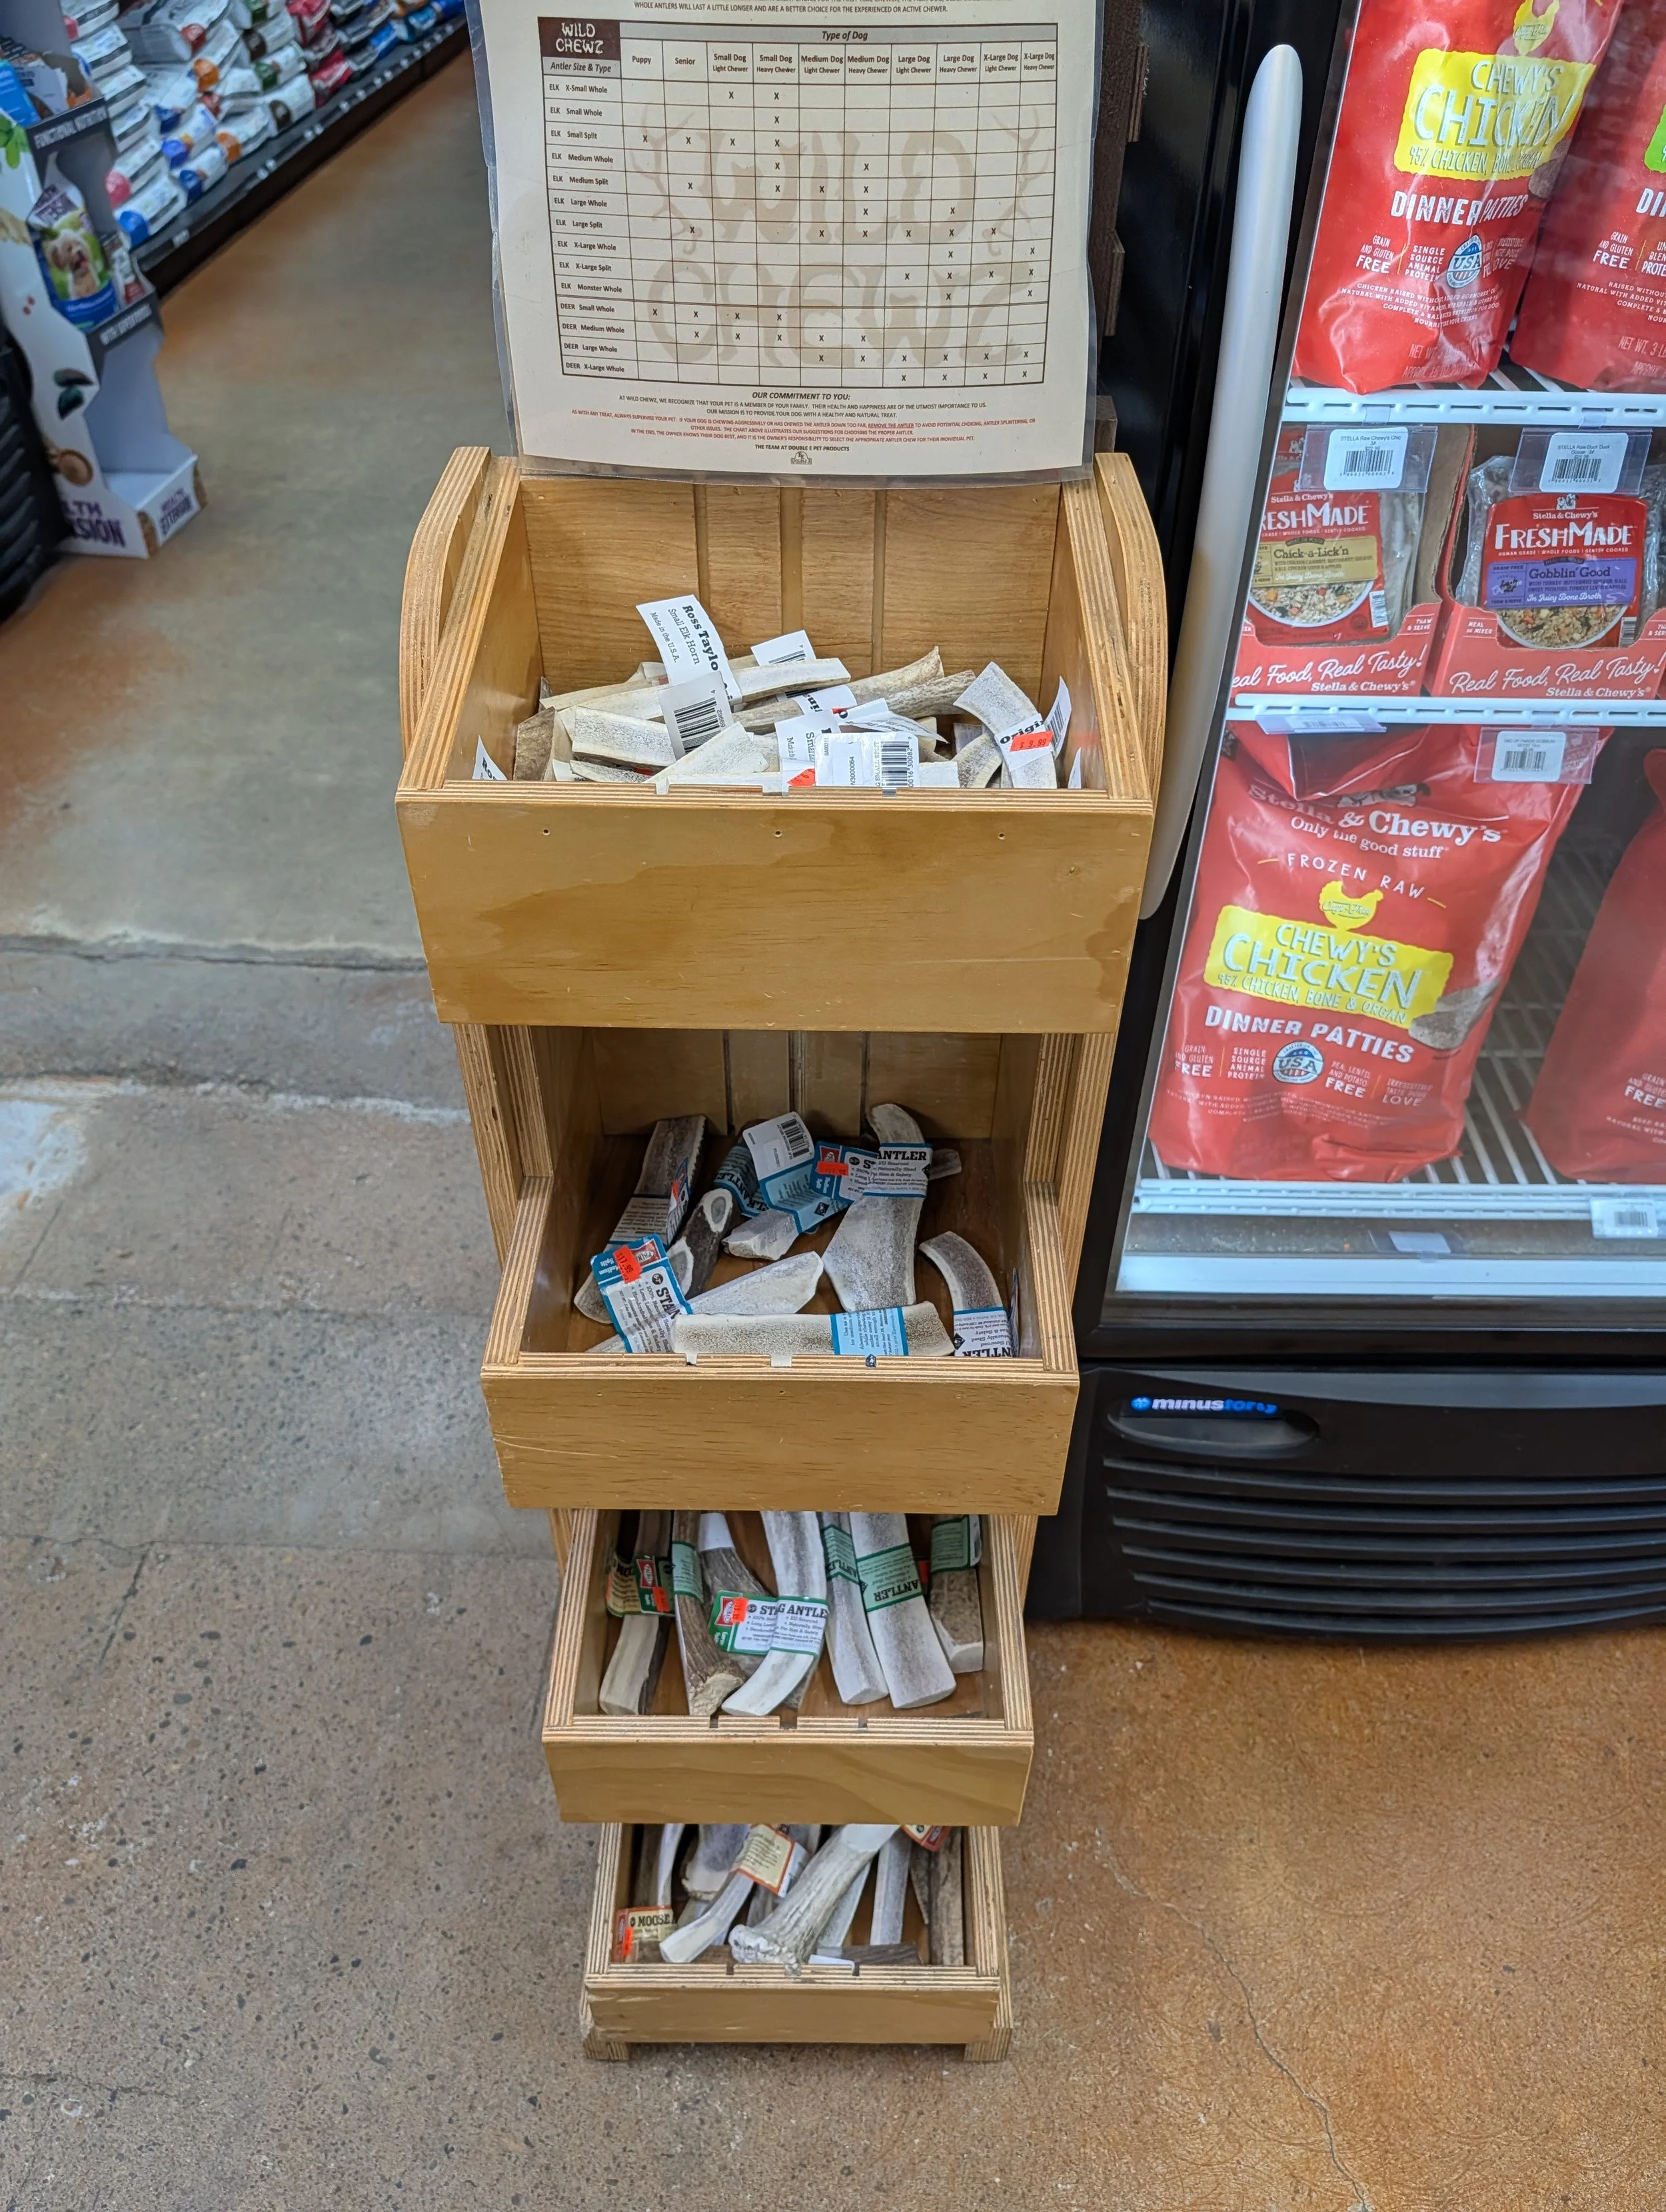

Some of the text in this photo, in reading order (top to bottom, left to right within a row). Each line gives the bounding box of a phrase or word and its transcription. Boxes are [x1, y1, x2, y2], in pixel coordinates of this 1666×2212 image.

[560, 23, 596, 38] WILD
[822, 31, 868, 41] Type of Dog
[556, 39, 604, 53] CHEWZ
[632, 56, 652, 65] Puppy
[714, 53, 747, 63] Small Dog
[759, 54, 792, 64] Small Dog
[801, 55, 844, 65] Medium Dog
[898, 55, 930, 65] Large Dog
[983, 53, 1018, 63] X-Large Dog
[1024, 52, 1054, 61] X-Large Dog
[550, 62, 572, 72] Antler
[573, 63, 586, 72] Size
[595, 63, 611, 74] Type
[712, 65, 727, 74] Light
[756, 66, 773, 75] Heavy
[1471, 60, 1564, 95] CHEWY'S
[565, 84, 587, 93] X-Small
[588, 85, 607, 94] Whole
[1414, 84, 1578, 148] CHICKEN
[567, 131, 584, 139] Small
[584, 131, 597, 141] Split
[1409, 146, 1429, 166] 95%
[569, 176, 594, 185] Medium
[595, 177, 608, 187] Split
[1391, 191, 1528, 225] DINNER PATTIES
[1373, 235, 1391, 248] GRAIN
[1611, 231, 1628, 243] GRAIN
[574, 241, 595, 251] X-Large
[596, 243, 616, 251] Whole
[1413, 245, 1446, 256] SINGLE
[1599, 239, 1634, 256] AND GLUTEN
[1361, 245, 1395, 261] AND GLUTEN
[1410, 253, 1443, 265] SOURCE
[1593, 250, 1630, 269] FREE
[1356, 255, 1391, 274] FREE
[1408, 261, 1441, 273] ANIMAL
[1453, 256, 1481, 271] USA
[1405, 269, 1441, 282] PROTEIN
[578, 304, 595, 312] Small
[596, 304, 615, 313] Whole
[752, 391, 767, 400] OUR
[769, 392, 820, 400] COMMITMENT
[1271, 494, 1294, 504] Stella
[1294, 493, 1301, 502] &
[1565, 511, 1598, 520] Chewy's
[1580, 567, 1611, 577] Good
[650, 612, 662, 628] Made
[659, 626, 665, 634] in
[662, 630, 671, 642] the
[668, 608, 700, 665] Small Elk Horn
[682, 605, 720, 671] Ross Taylo
[1232, 666, 1262, 688] eal
[1318, 654, 1366, 681] Real
[1449, 670, 1499, 694] Real
[1555, 659, 1605, 686] Real
[1311, 680, 1409, 693] Stella & Chewy's
[1545, 687, 1645, 699] Stella & Chewy's
[1337, 811, 1365, 828] &
[1368, 810, 1502, 847] Chewy's
[1290, 815, 1444, 860] Only good stuff
[1287, 852, 1425, 900] FROZEN RAW
[1275, 923, 1397, 967] CHEWY'S
[1223, 931, 1423, 1011] CHICKEN
[1218, 973, 1238, 988] 95%
[1306, 989, 1341, 1009] BONE
[1347, 996, 1357, 1011] &
[1361, 1001, 1407, 1025] ORGAN
[1205, 1005, 1415, 1064] DINNER PATTIES
[1233, 1047, 1267, 1057] SINGLE
[1231, 1056, 1267, 1065] SOURCE
[1279, 1056, 1317, 1072] USA
[1174, 1061, 1213, 1078] FREE
[1229, 1064, 1265, 1073] ANIMAL
[1325, 1077, 1367, 1099] FREE
[1381, 1093, 1423, 1108] LOVE
[1624, 1085, 1666, 1109] FREE
[874, 1579, 920, 1602] ANTLER
